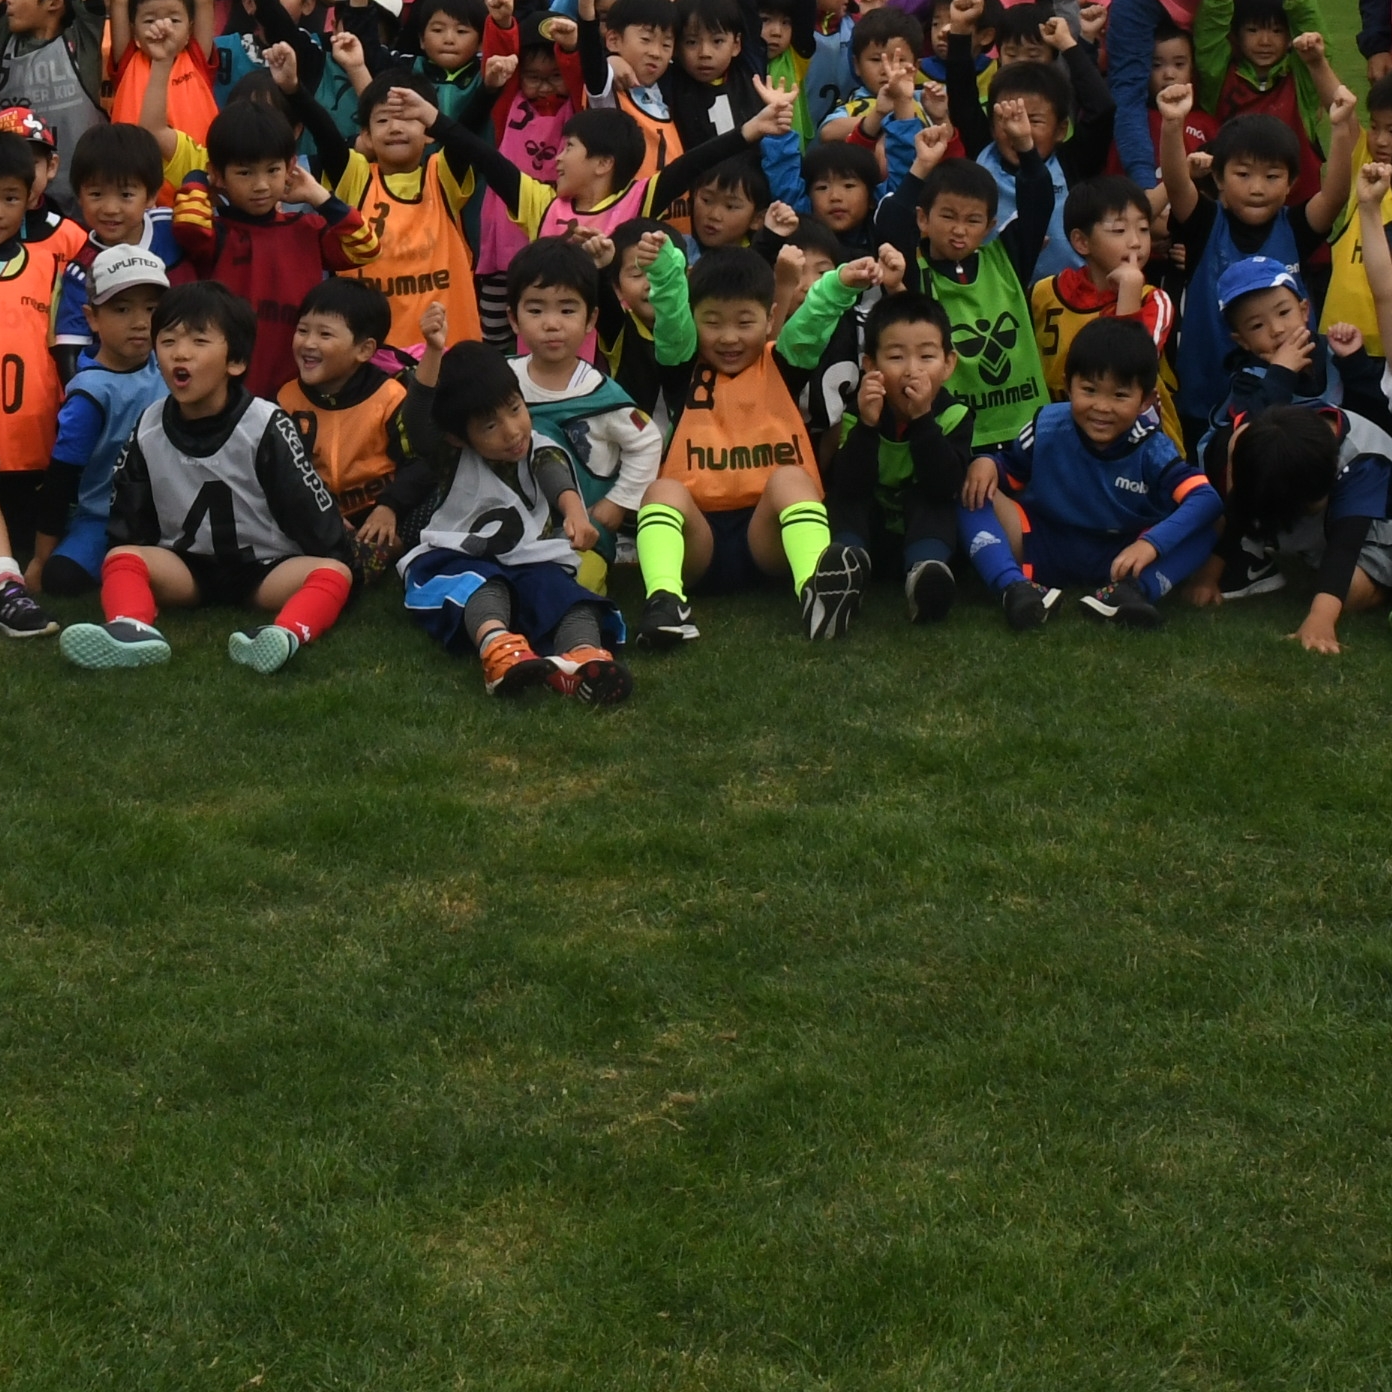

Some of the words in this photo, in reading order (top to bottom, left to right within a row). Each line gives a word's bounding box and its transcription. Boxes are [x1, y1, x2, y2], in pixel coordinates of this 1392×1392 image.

[708, 94, 735, 136] 1
[107, 257, 159, 274] UPLIFTED
[1041, 308, 1064, 356] 5
[276, 416, 333, 513] Kappa
[686, 434, 804, 471] hummel
